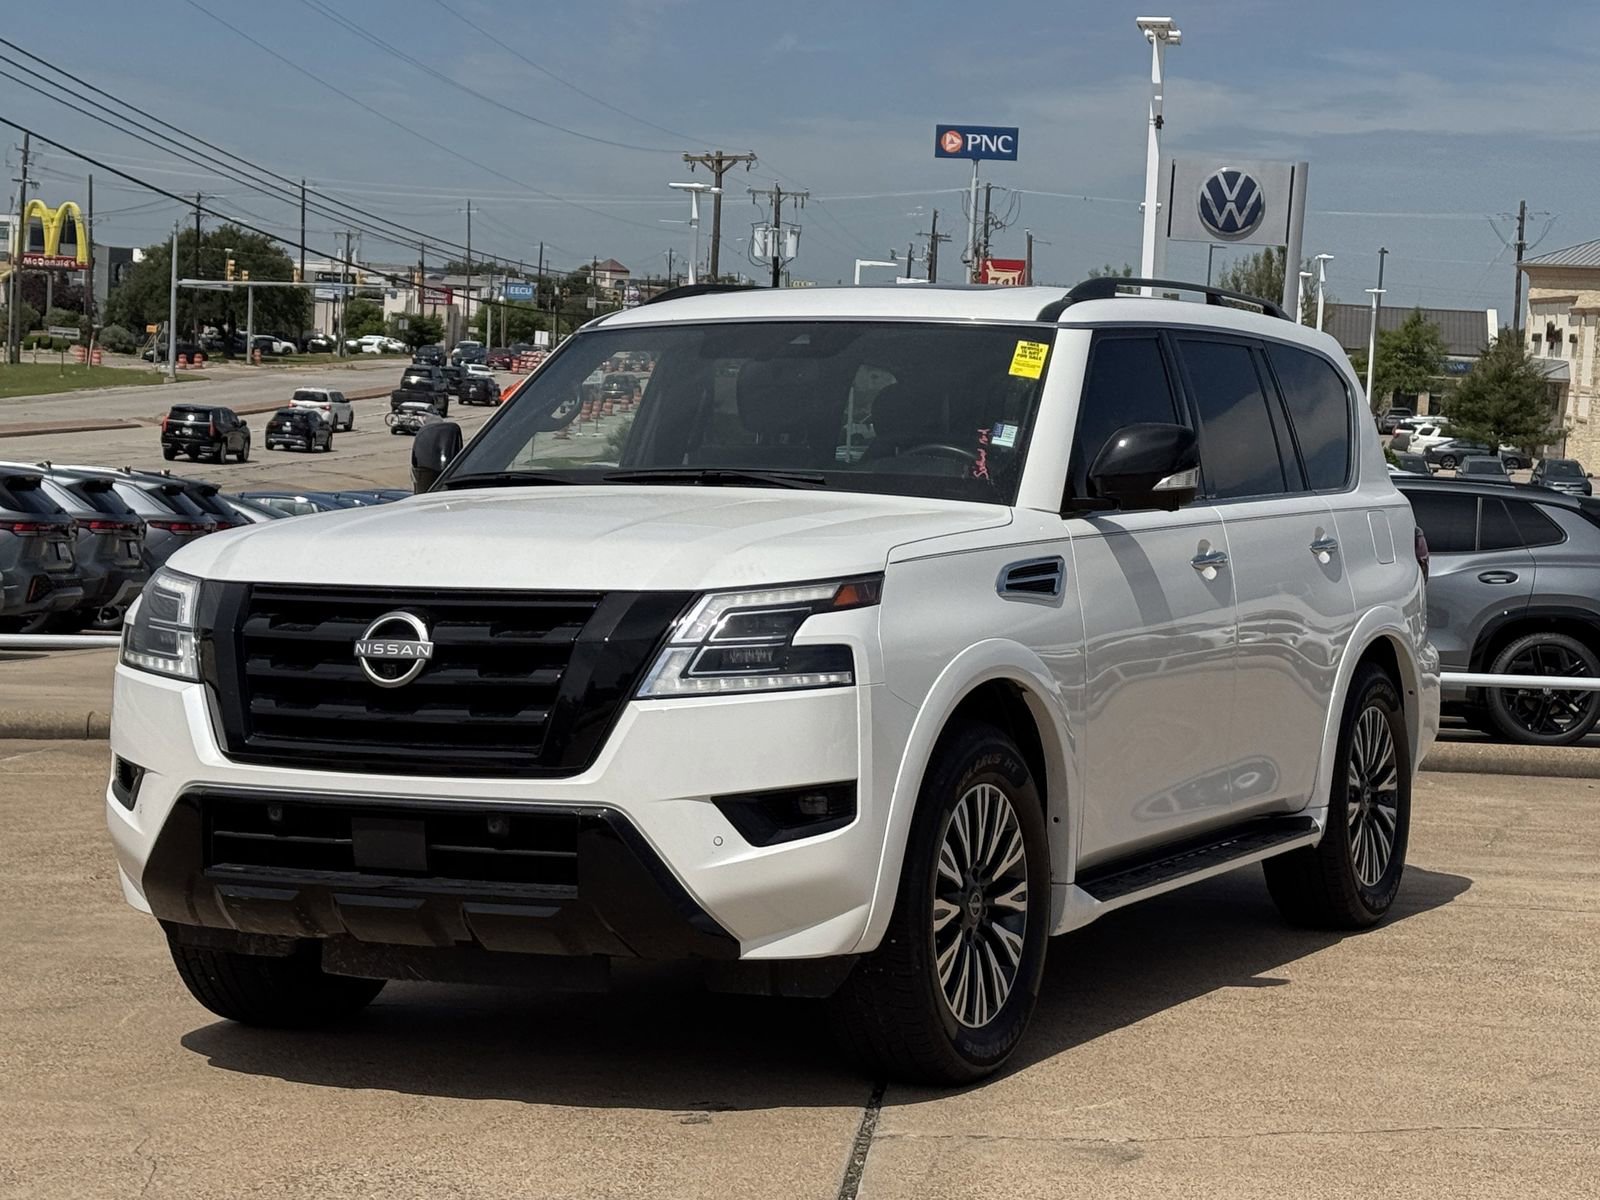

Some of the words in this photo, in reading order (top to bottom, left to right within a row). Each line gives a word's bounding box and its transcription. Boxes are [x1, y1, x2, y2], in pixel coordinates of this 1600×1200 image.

[966, 133, 1013, 153] PNC
[23, 257, 76, 267] McDonald's
[510, 286, 532, 295] EECU
[355, 643, 430, 656] NISSAN
